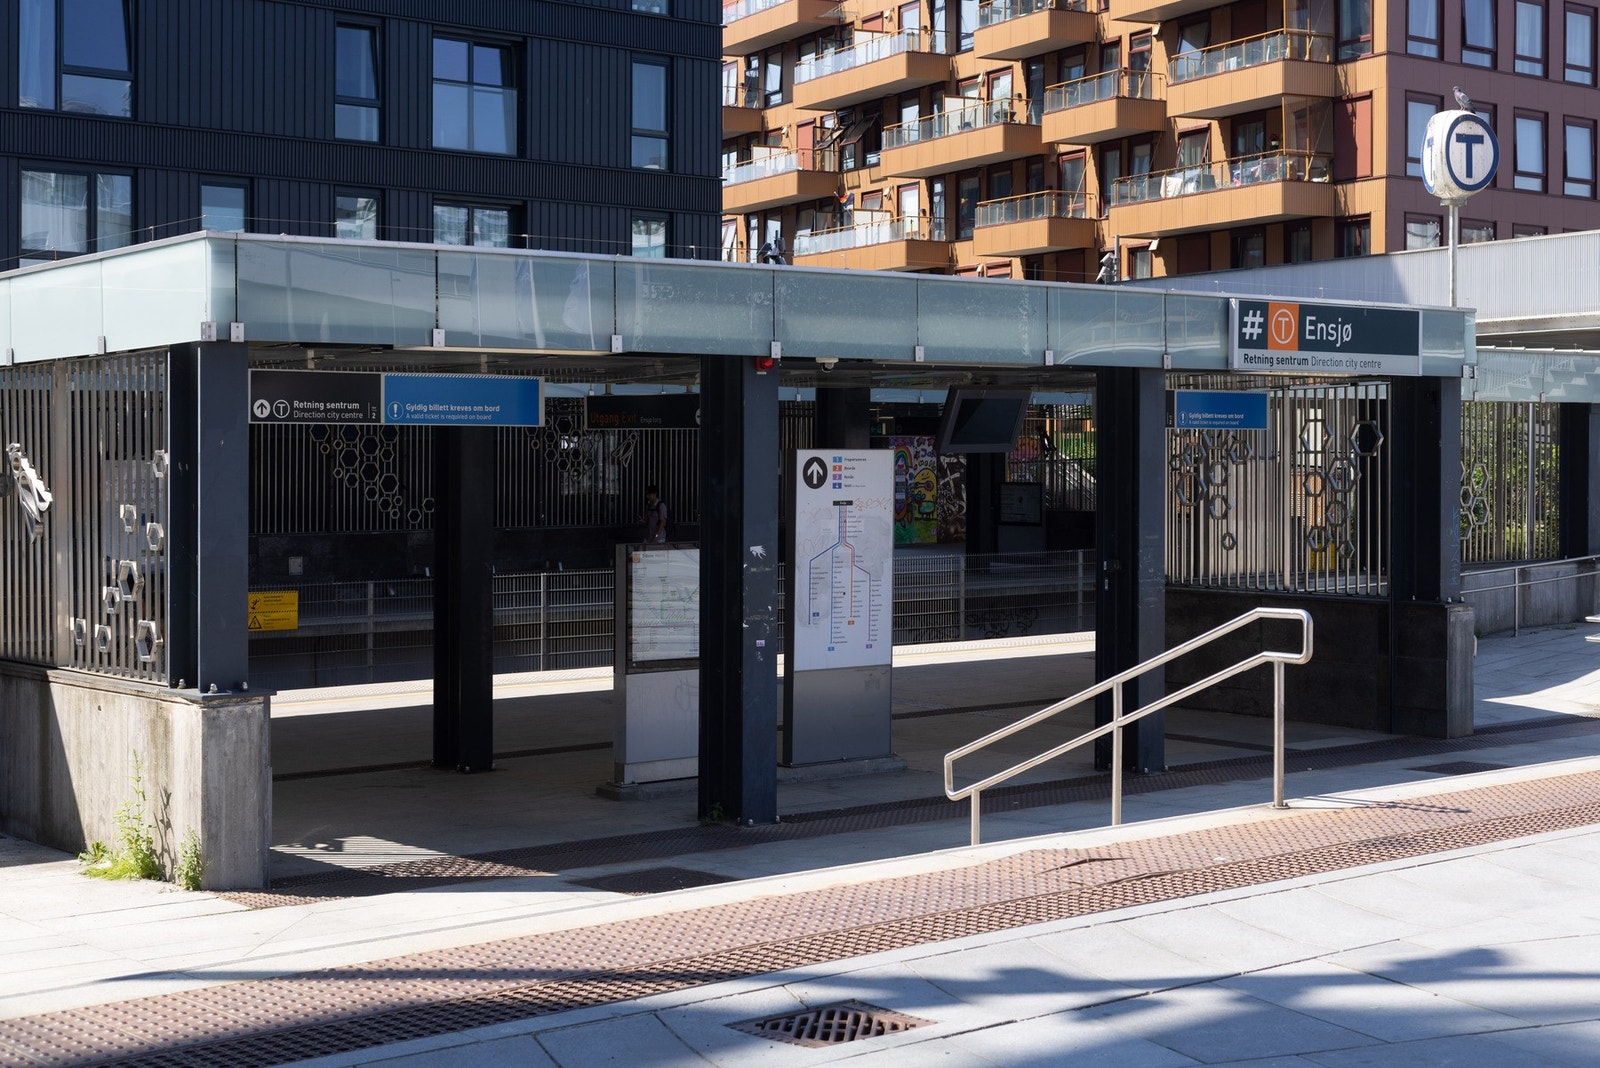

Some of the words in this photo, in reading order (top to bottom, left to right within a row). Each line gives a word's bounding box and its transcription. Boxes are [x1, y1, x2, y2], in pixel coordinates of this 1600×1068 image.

[1456, 133, 1484, 178] T
[1305, 315, 1352, 348] Ensjø
[1243, 353, 1274, 366] Retning
[1276, 354, 1309, 366] sentrum
[1311, 355, 1343, 367] Direction
[1345, 357, 1359, 370] city
[1359, 358, 1382, 369] centre
[293, 400, 324, 411] Retning
[326, 402, 360, 410] sentrum
[405, 403, 428, 412] Gyldig
[293, 410, 325, 418] Direction
[326, 410, 340, 420] city
